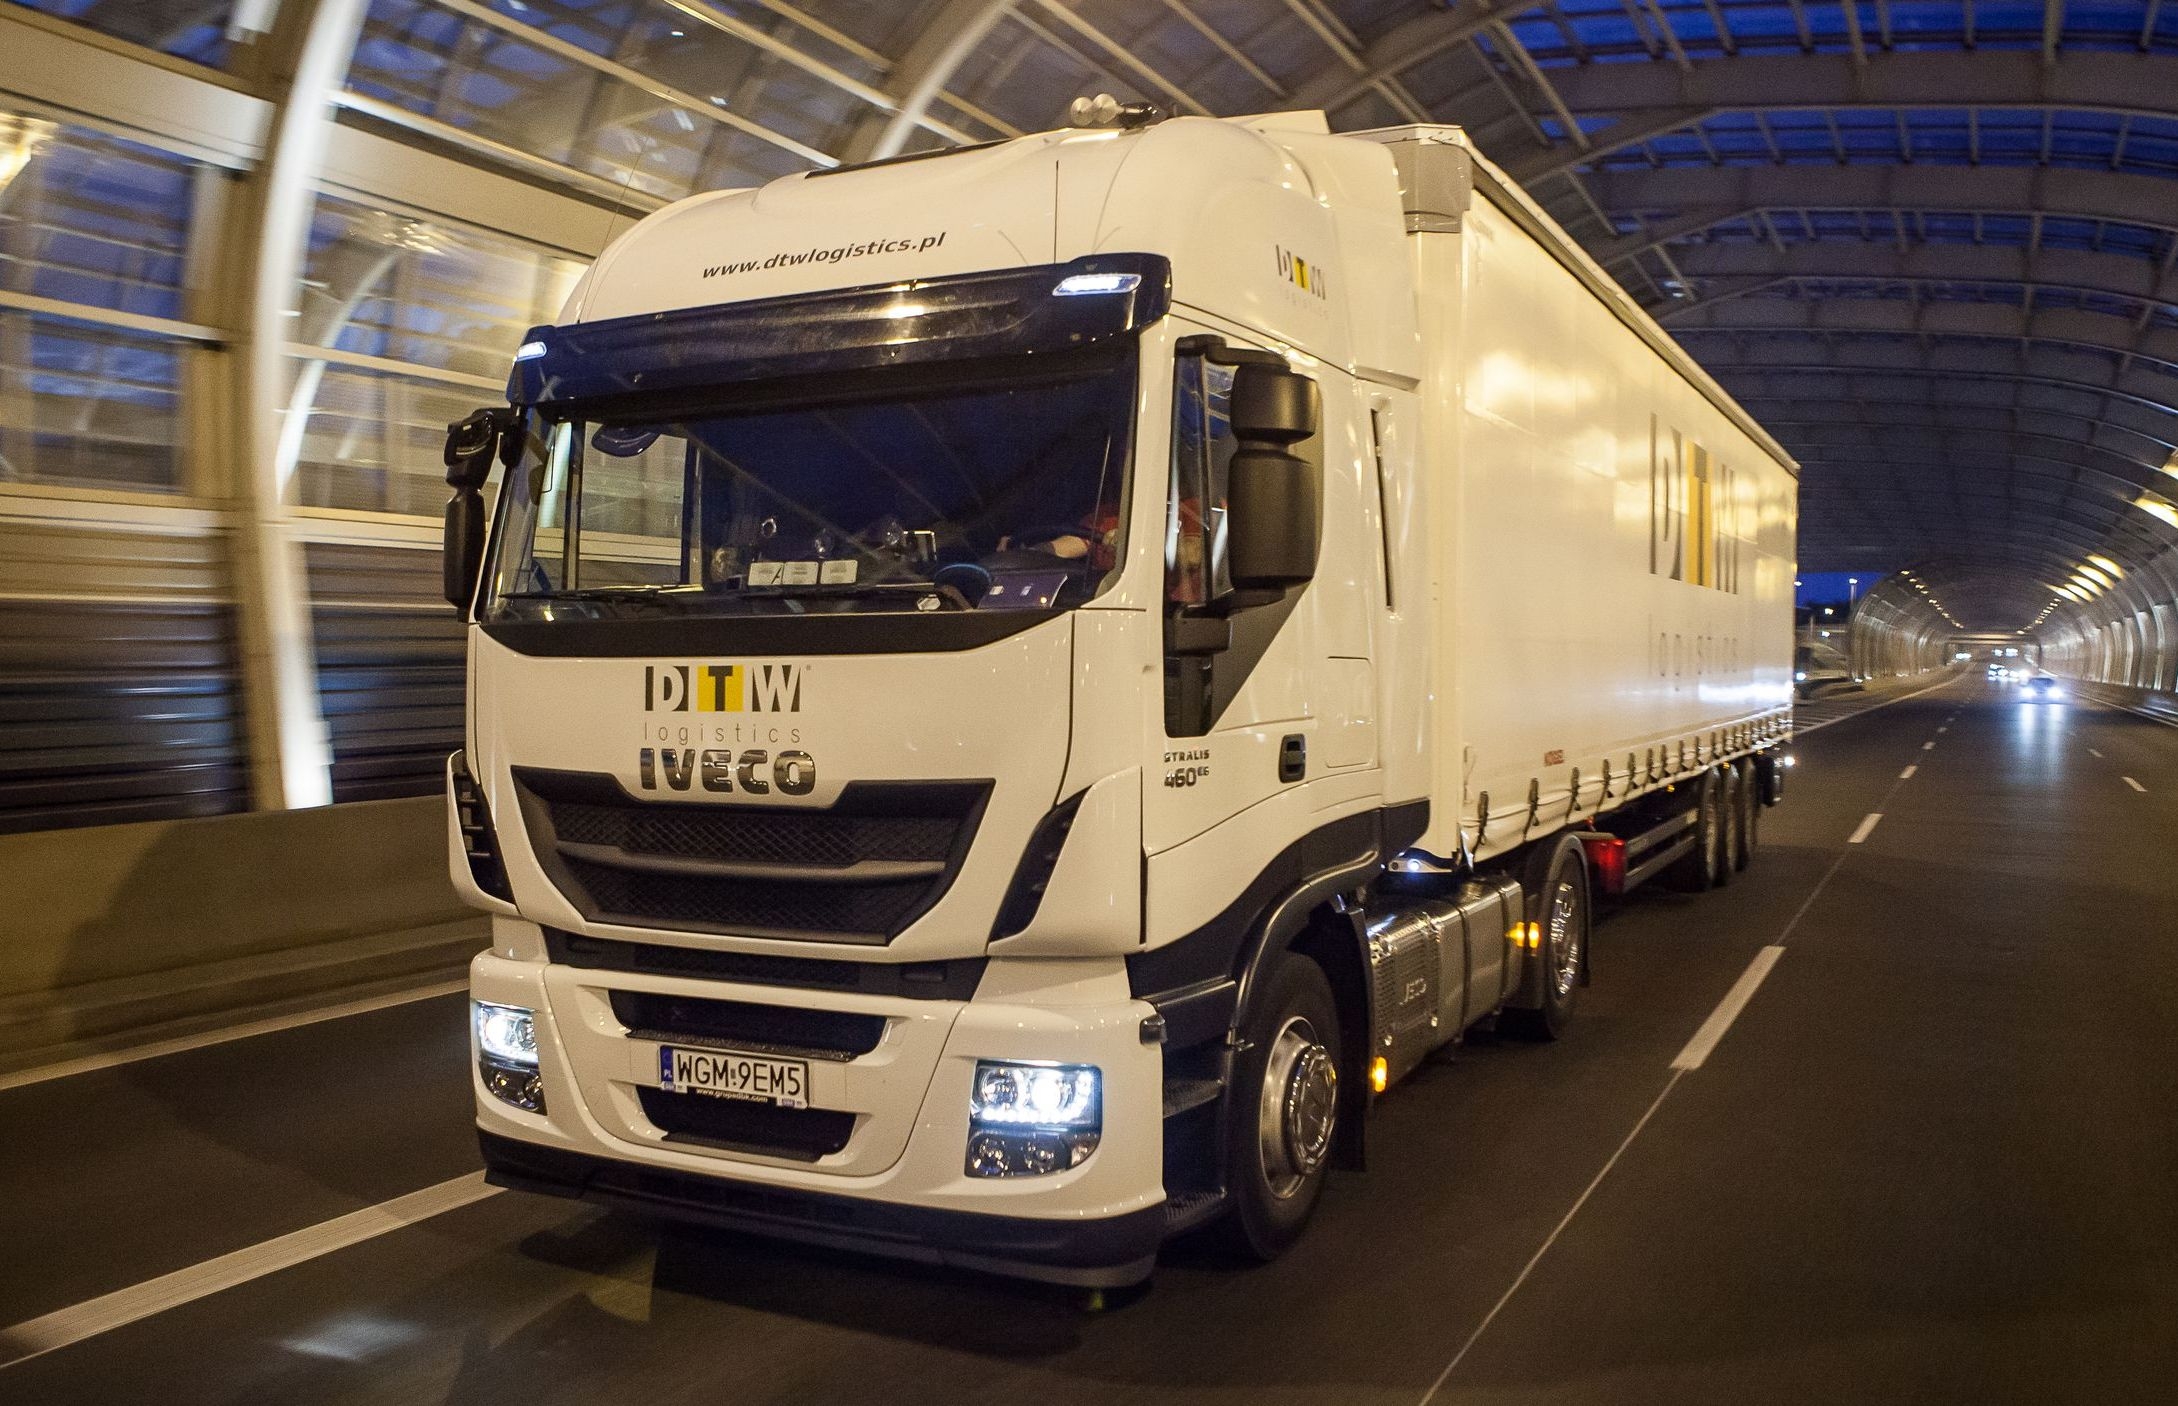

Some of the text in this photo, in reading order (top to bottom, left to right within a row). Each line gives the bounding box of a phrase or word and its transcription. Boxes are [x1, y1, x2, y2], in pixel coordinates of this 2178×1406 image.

[702, 231, 947, 278] www.dtwlogistics.pl
[644, 664, 801, 712] DTW
[644, 722, 801, 745] logistics
[640, 747, 816, 796] IVECO
